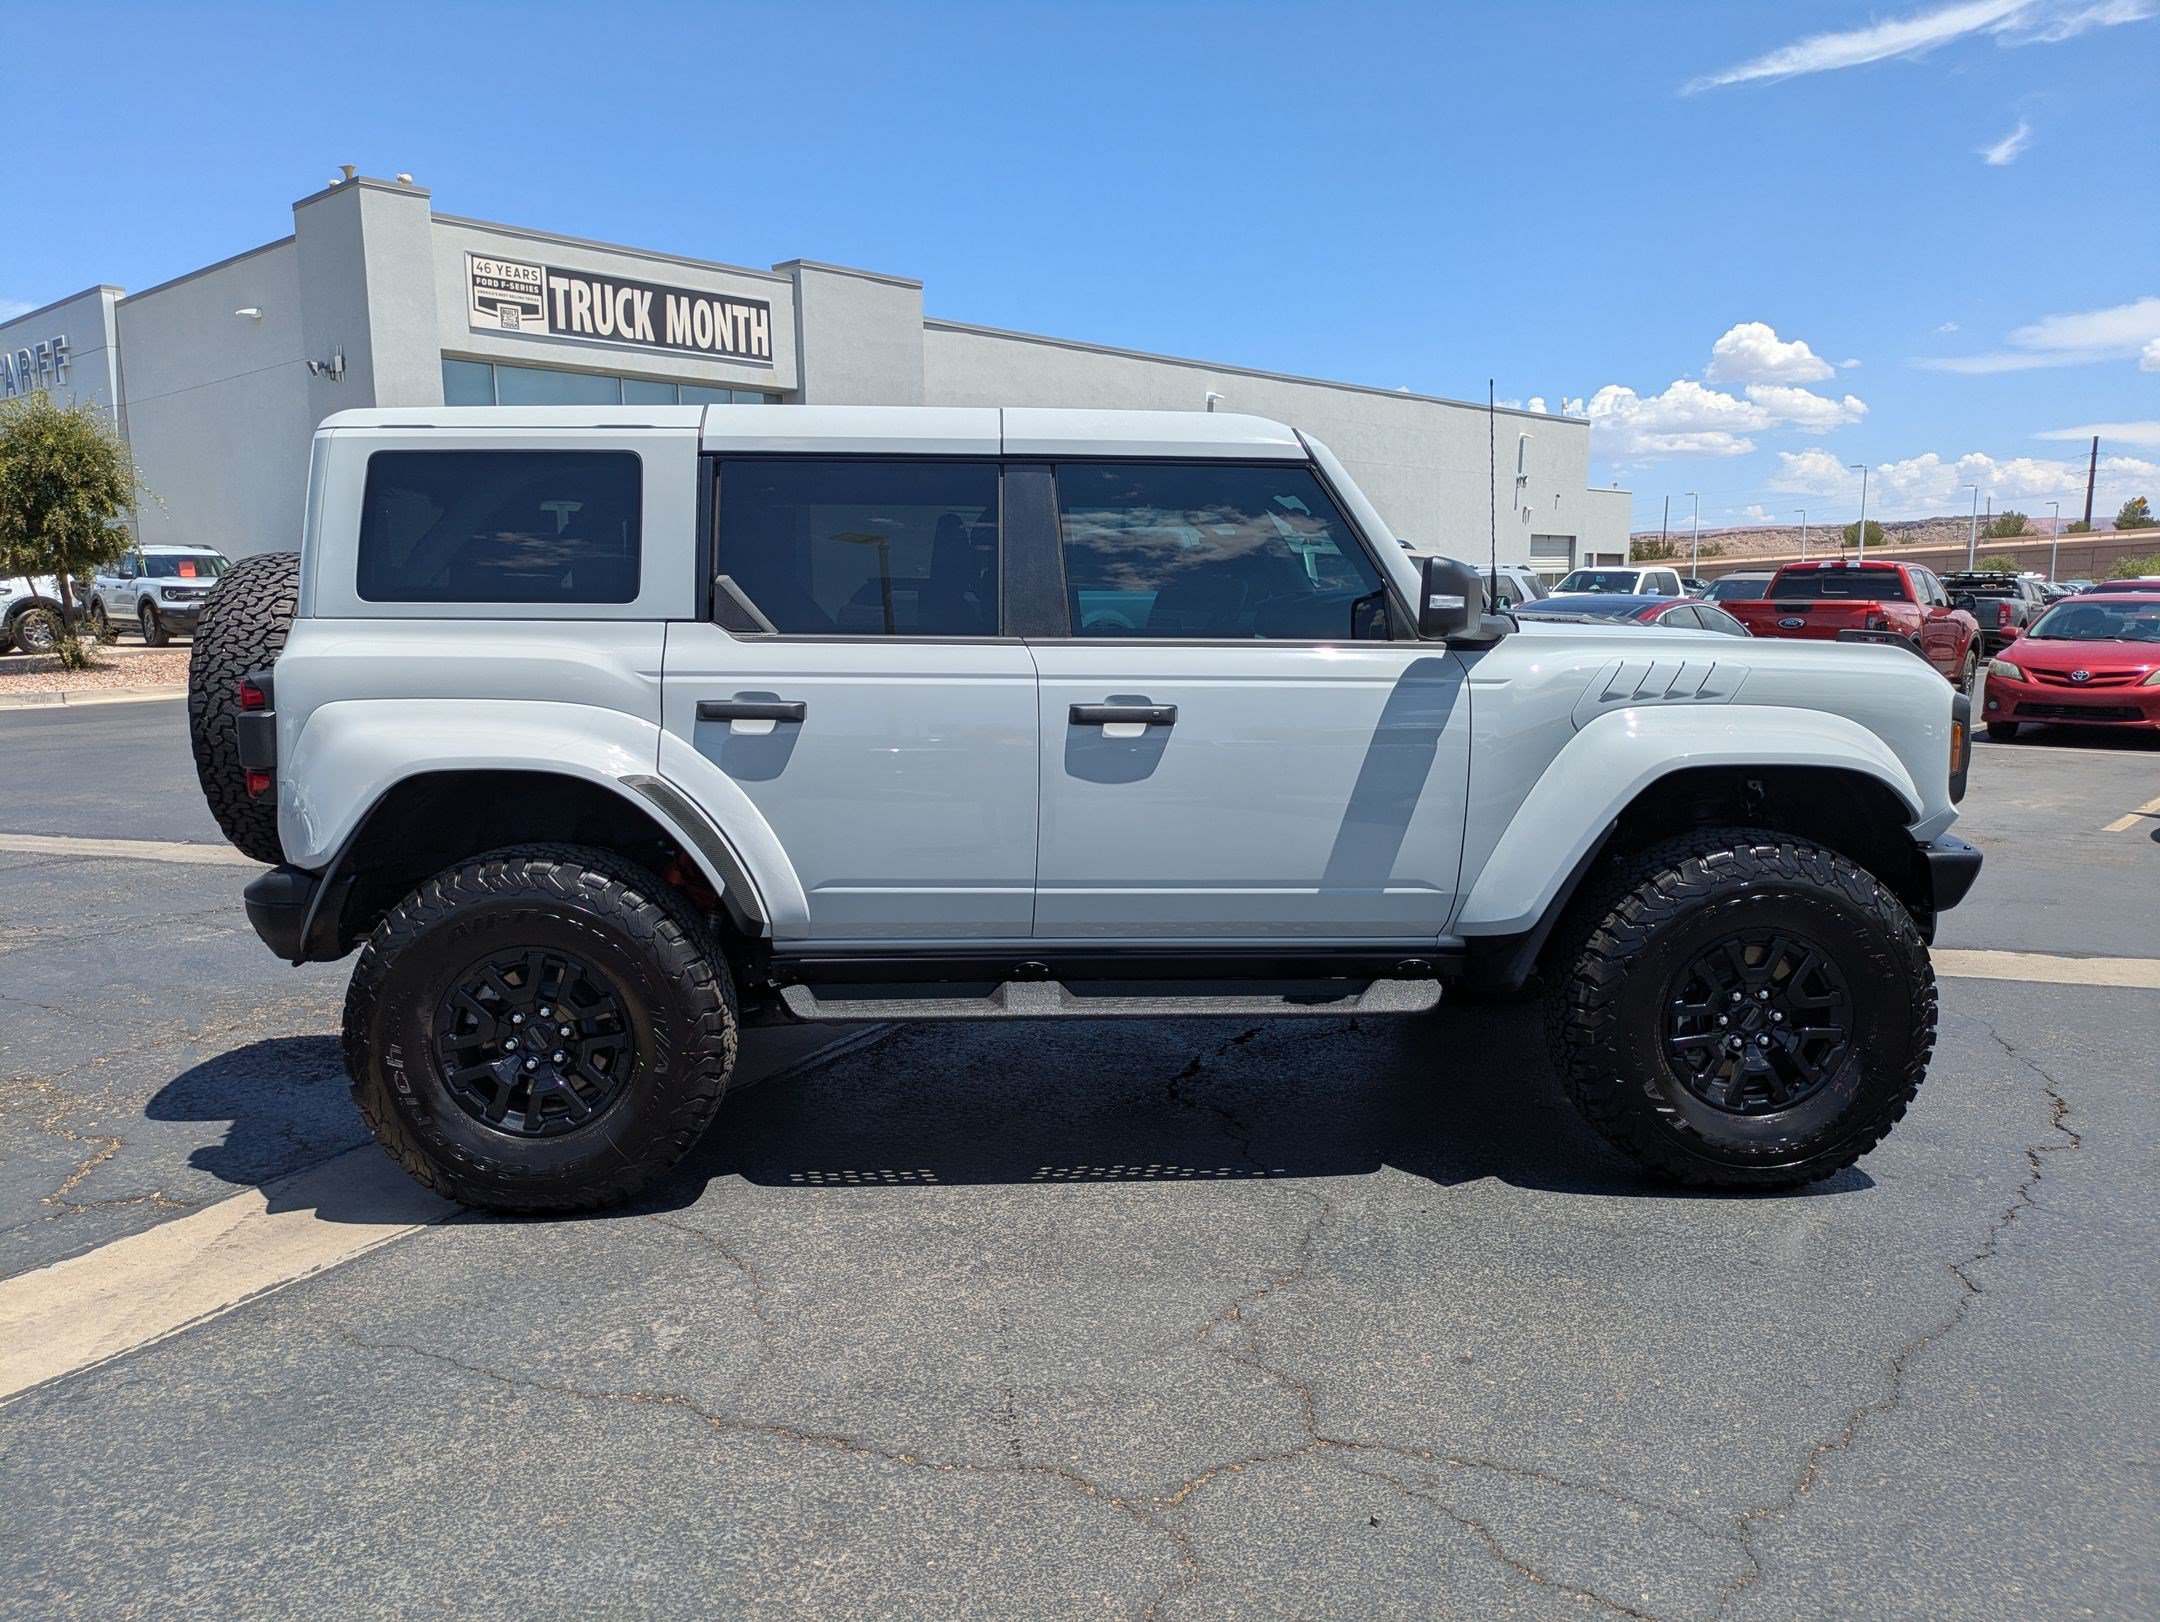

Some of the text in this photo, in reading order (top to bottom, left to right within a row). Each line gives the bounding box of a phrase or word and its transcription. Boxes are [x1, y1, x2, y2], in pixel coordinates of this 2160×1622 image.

[476, 261, 538, 281] 46 YEARS
[476, 277, 539, 293] FORD F-SERIES
[549, 276, 769, 357] TRUCK MONTH
[0, 335, 70, 398] ARFF
